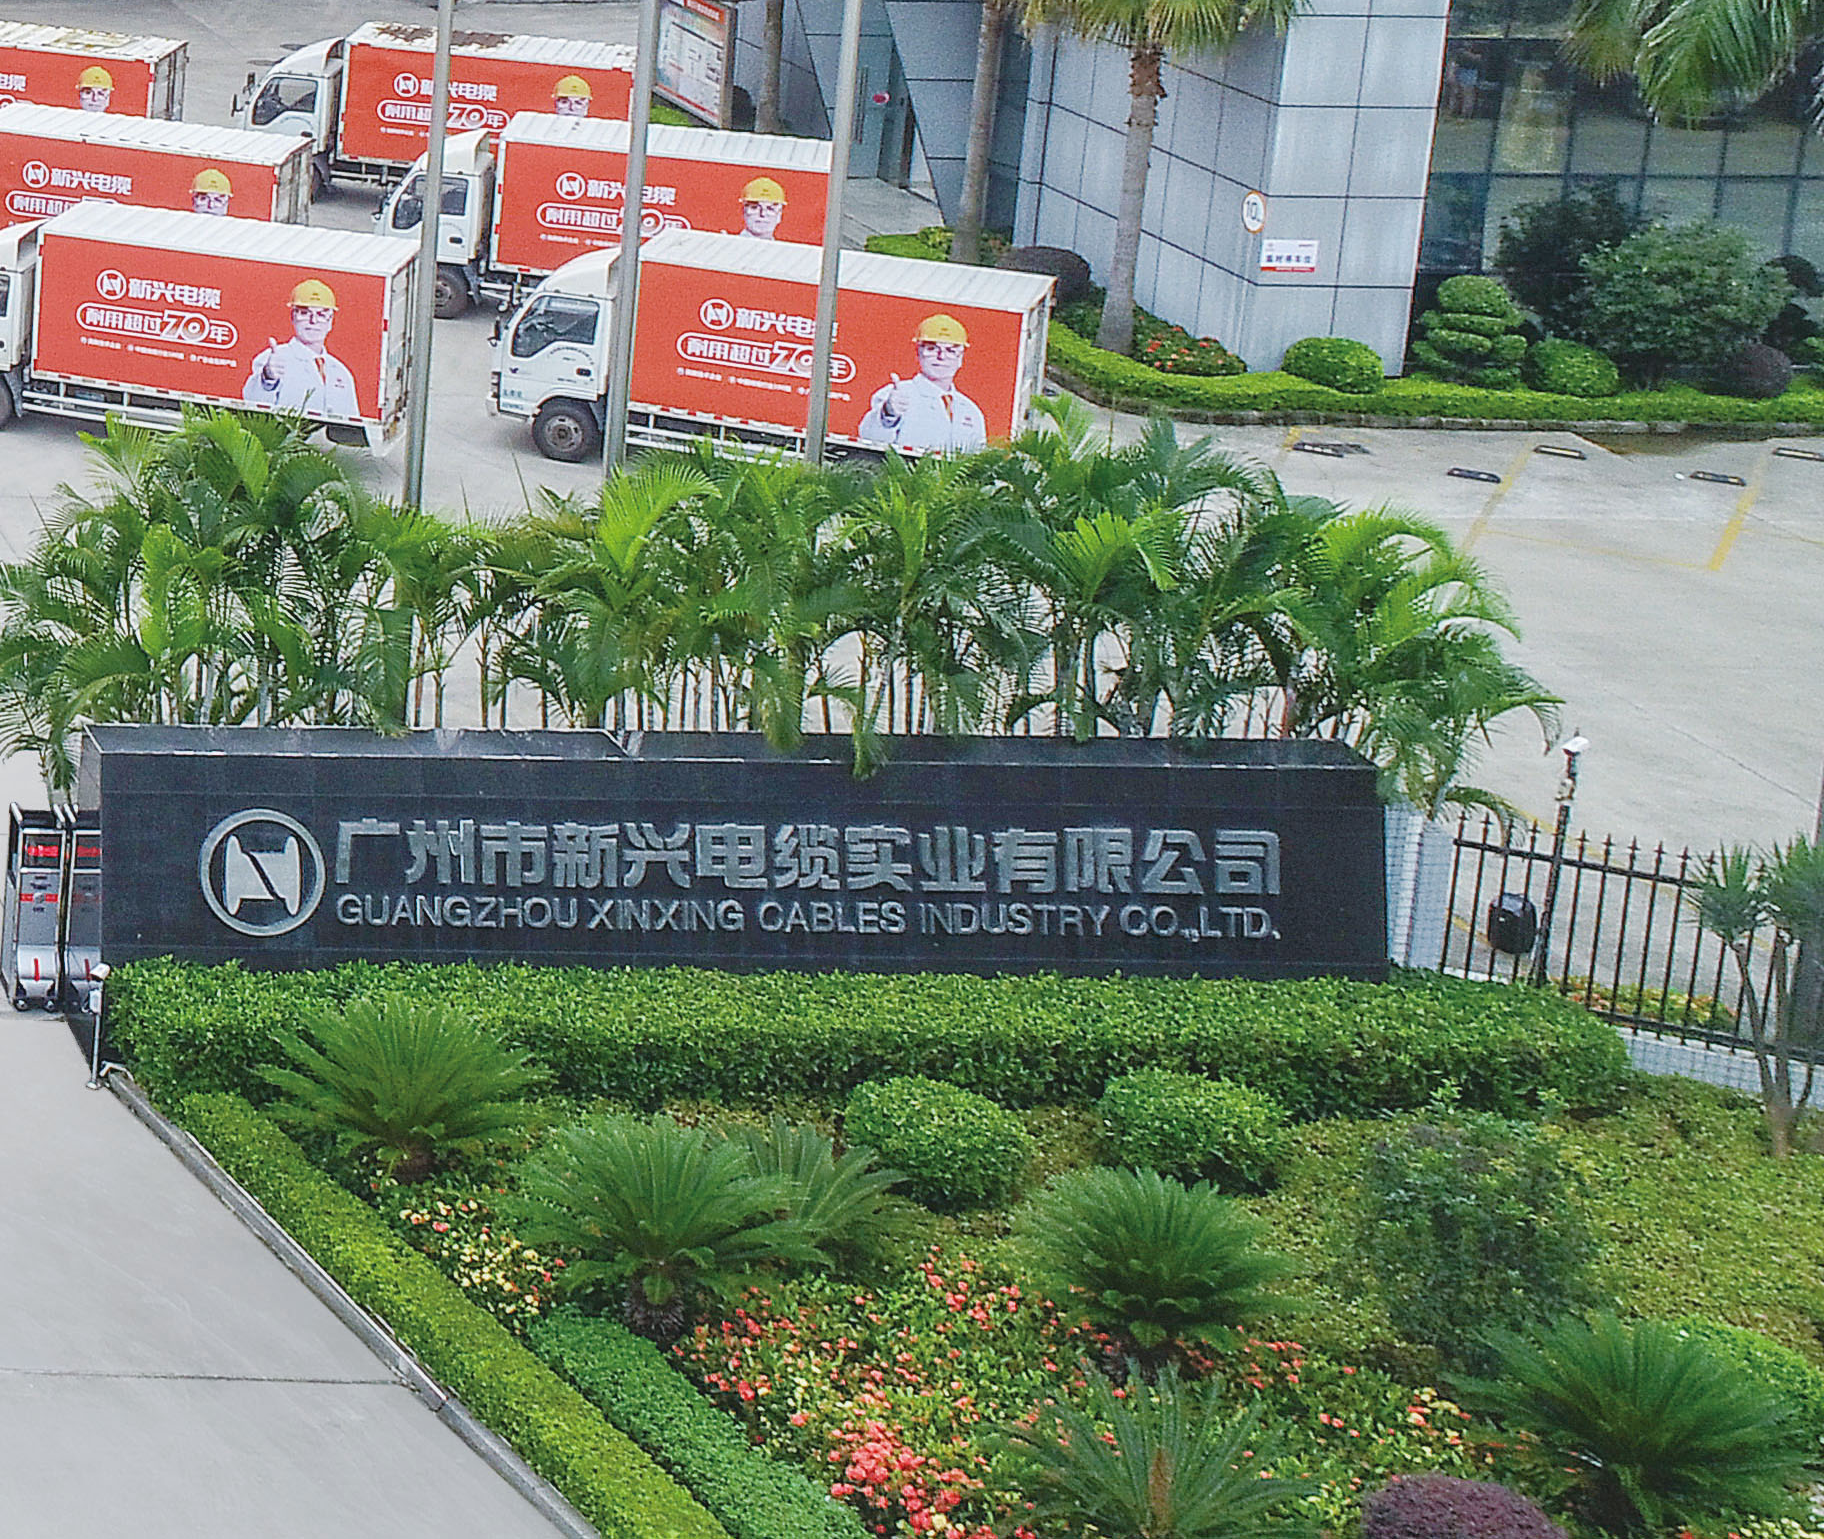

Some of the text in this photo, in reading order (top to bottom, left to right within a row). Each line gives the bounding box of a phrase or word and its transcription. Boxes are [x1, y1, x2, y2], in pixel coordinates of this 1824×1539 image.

[384, 101, 505, 130] 耐用超70年
[50, 167, 134, 196] 新兴电缆
[127, 277, 222, 310] 新兴电缆
[85, 307, 231, 344] 耐用超过70年
[734, 306, 839, 344] 新兴电
[335, 817, 1281, 896] 广州市新兴电缆实业有限公司
[335, 894, 1282, 942] GUANGZHOU XINXING CABLES INDUSTRY CO.,LTD.
